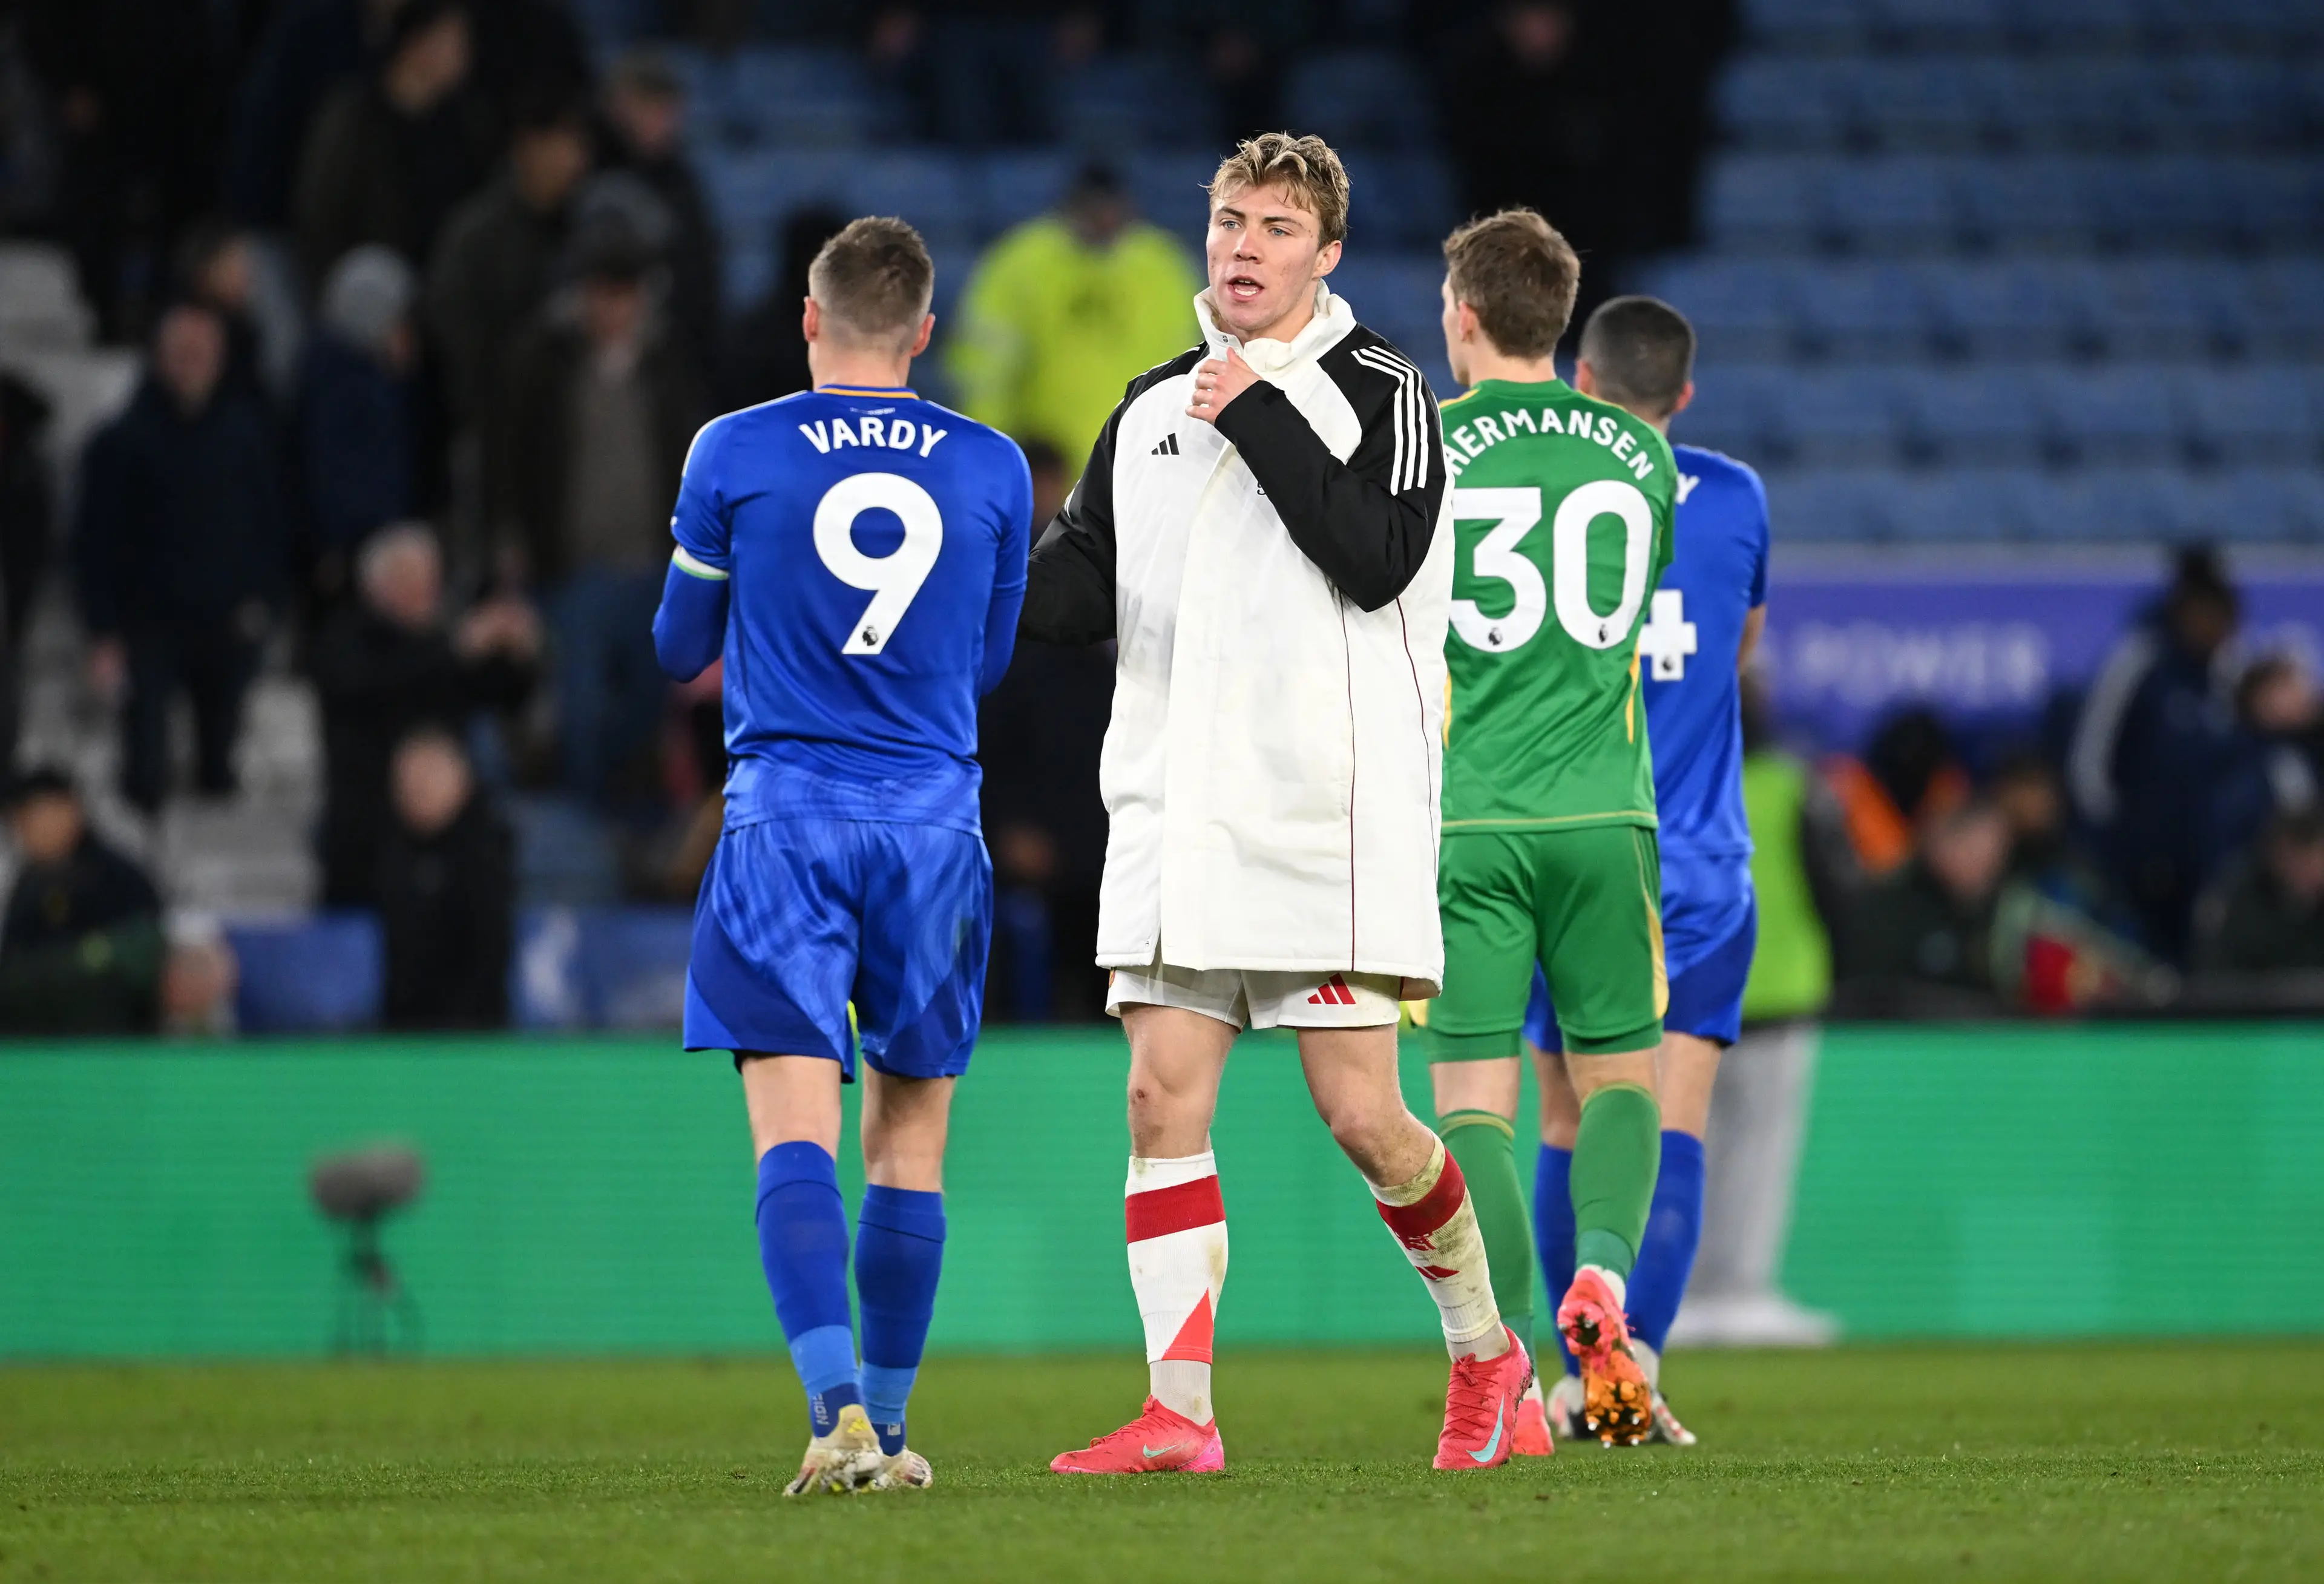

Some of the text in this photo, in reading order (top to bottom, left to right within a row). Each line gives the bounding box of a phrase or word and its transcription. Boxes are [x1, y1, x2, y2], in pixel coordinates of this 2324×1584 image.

[798, 416, 948, 458] VARDY
[1443, 407, 1655, 481] HERMANSEN
[813, 472, 944, 655] 9
[1449, 479, 1653, 652] 30
